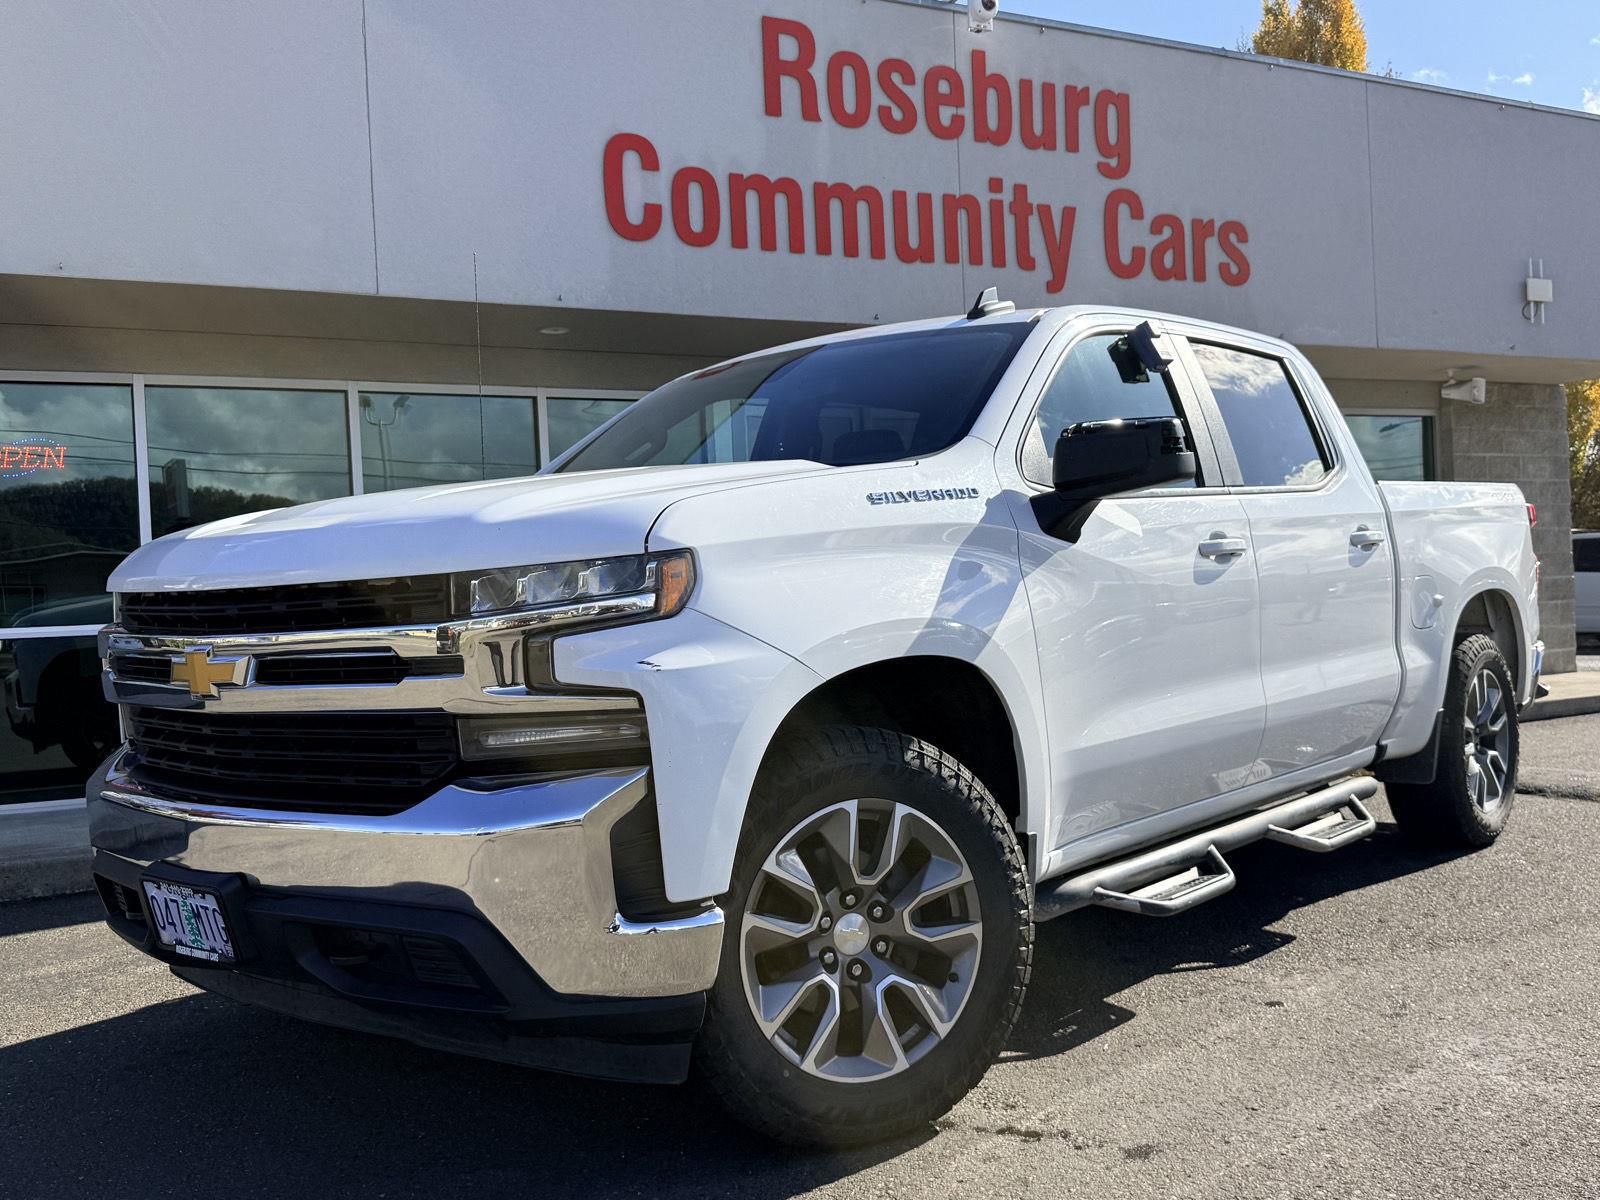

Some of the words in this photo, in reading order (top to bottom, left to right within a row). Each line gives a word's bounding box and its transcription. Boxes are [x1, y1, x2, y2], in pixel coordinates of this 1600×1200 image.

[762, 15, 1130, 179] Roseburg
[603, 133, 1076, 294] Community
[1104, 188, 1249, 286] Cars
[0, 446, 66, 469] PEN
